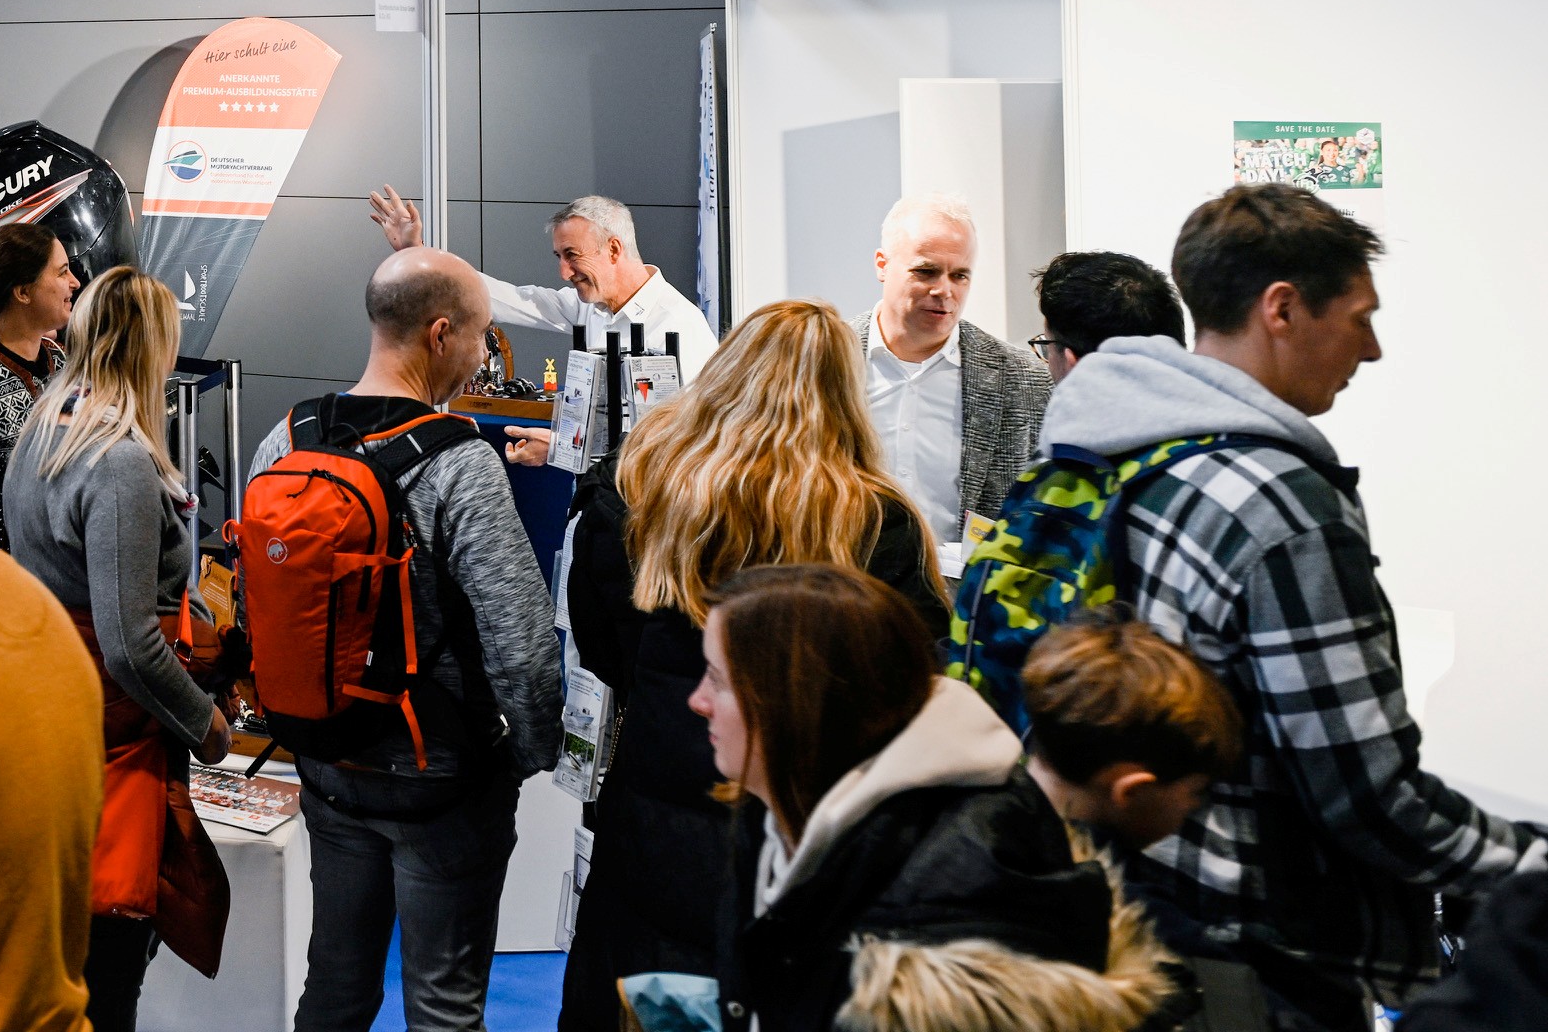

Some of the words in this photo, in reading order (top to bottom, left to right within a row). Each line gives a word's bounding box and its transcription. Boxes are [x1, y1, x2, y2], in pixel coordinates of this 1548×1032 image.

[204, 49, 231, 63] Hier
[234, 41, 270, 59] schult
[272, 39, 297, 53] eine
[219, 74, 280, 83] ANERKANNTE
[182, 86, 317, 97] PREMIUM-AUSBILDUNGSSTÄTTE
[1275, 125, 1295, 133] SAVE
[1298, 125, 1312, 133] THE
[1244, 152, 1307, 168] MATCH
[1245, 168, 1286, 183] DAY!
